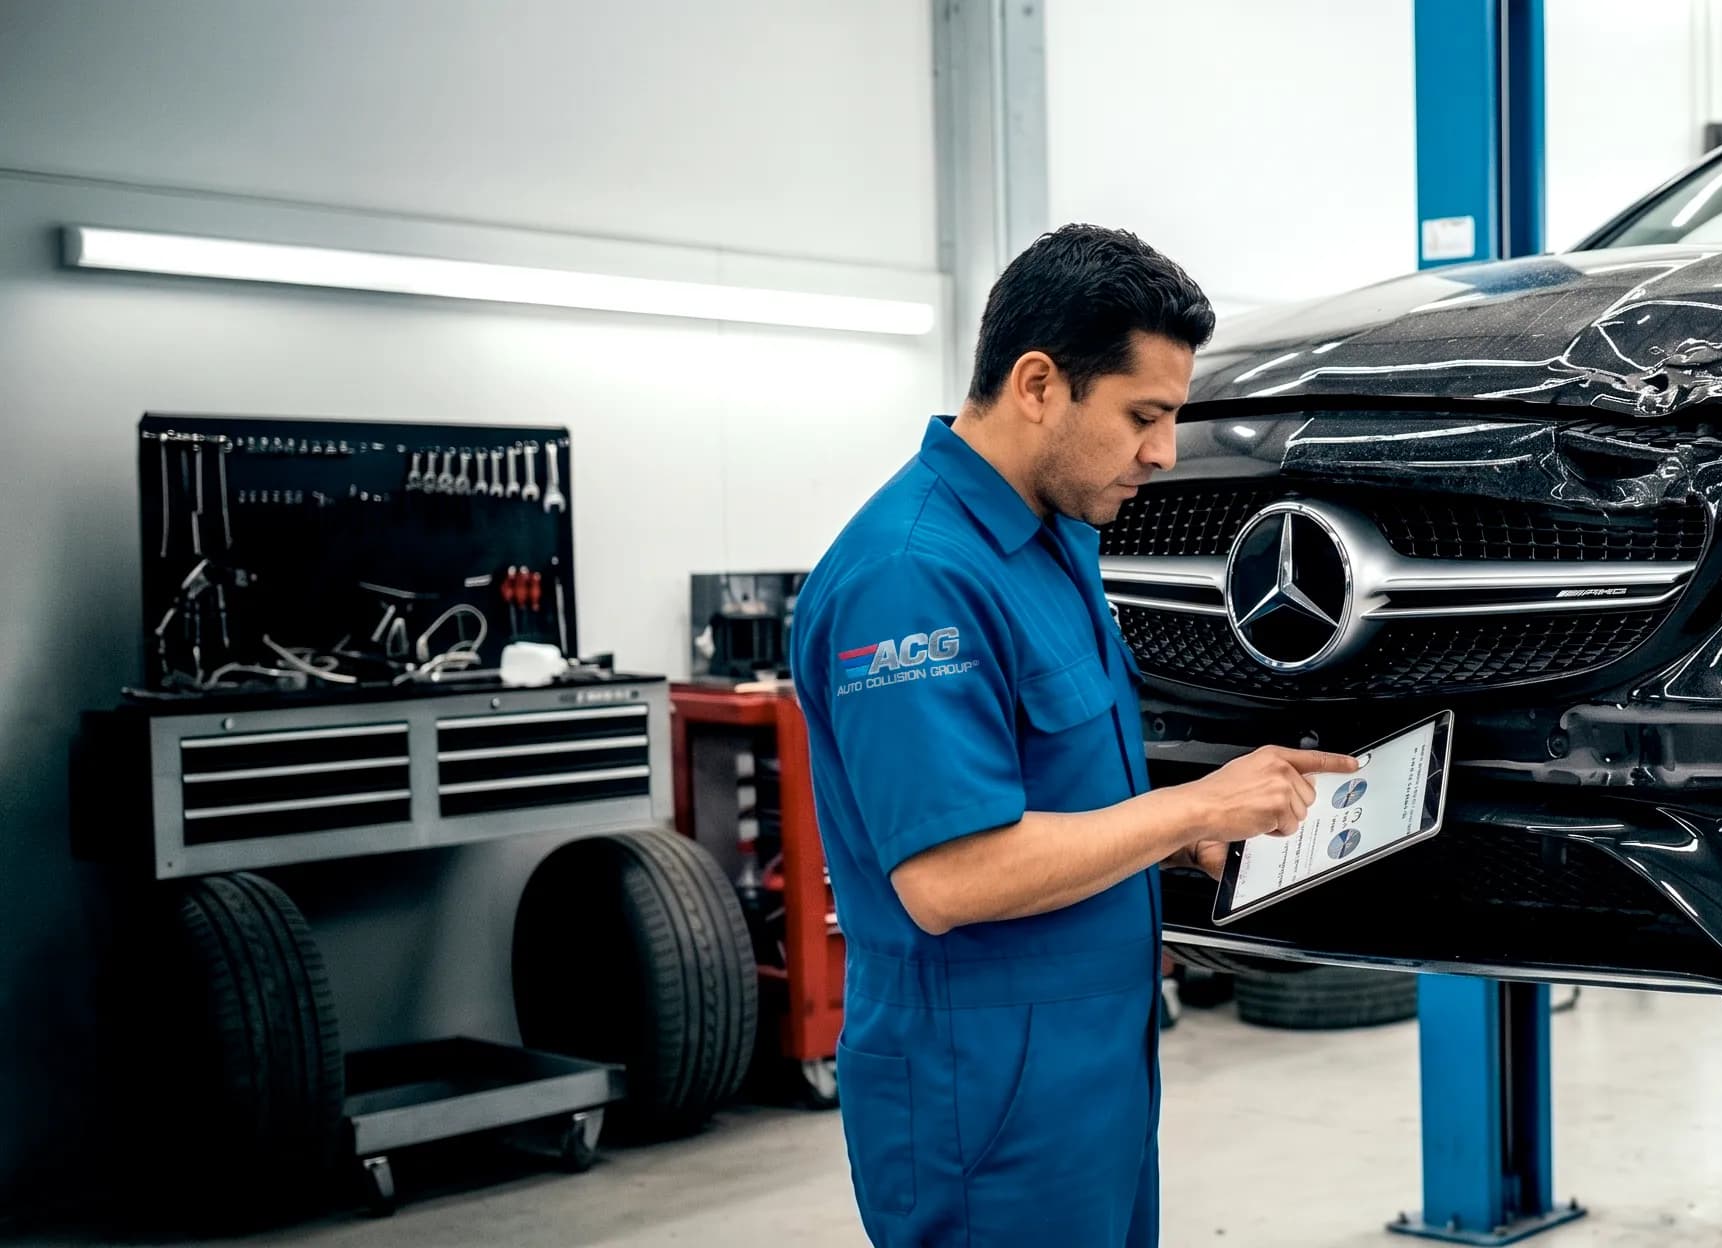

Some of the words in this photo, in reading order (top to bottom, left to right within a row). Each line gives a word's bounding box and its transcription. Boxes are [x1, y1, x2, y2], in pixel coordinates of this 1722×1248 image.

[868, 627, 960, 675] ACG
[837, 681, 863, 696] AUTO
[866, 669, 927, 689] COLLISION
